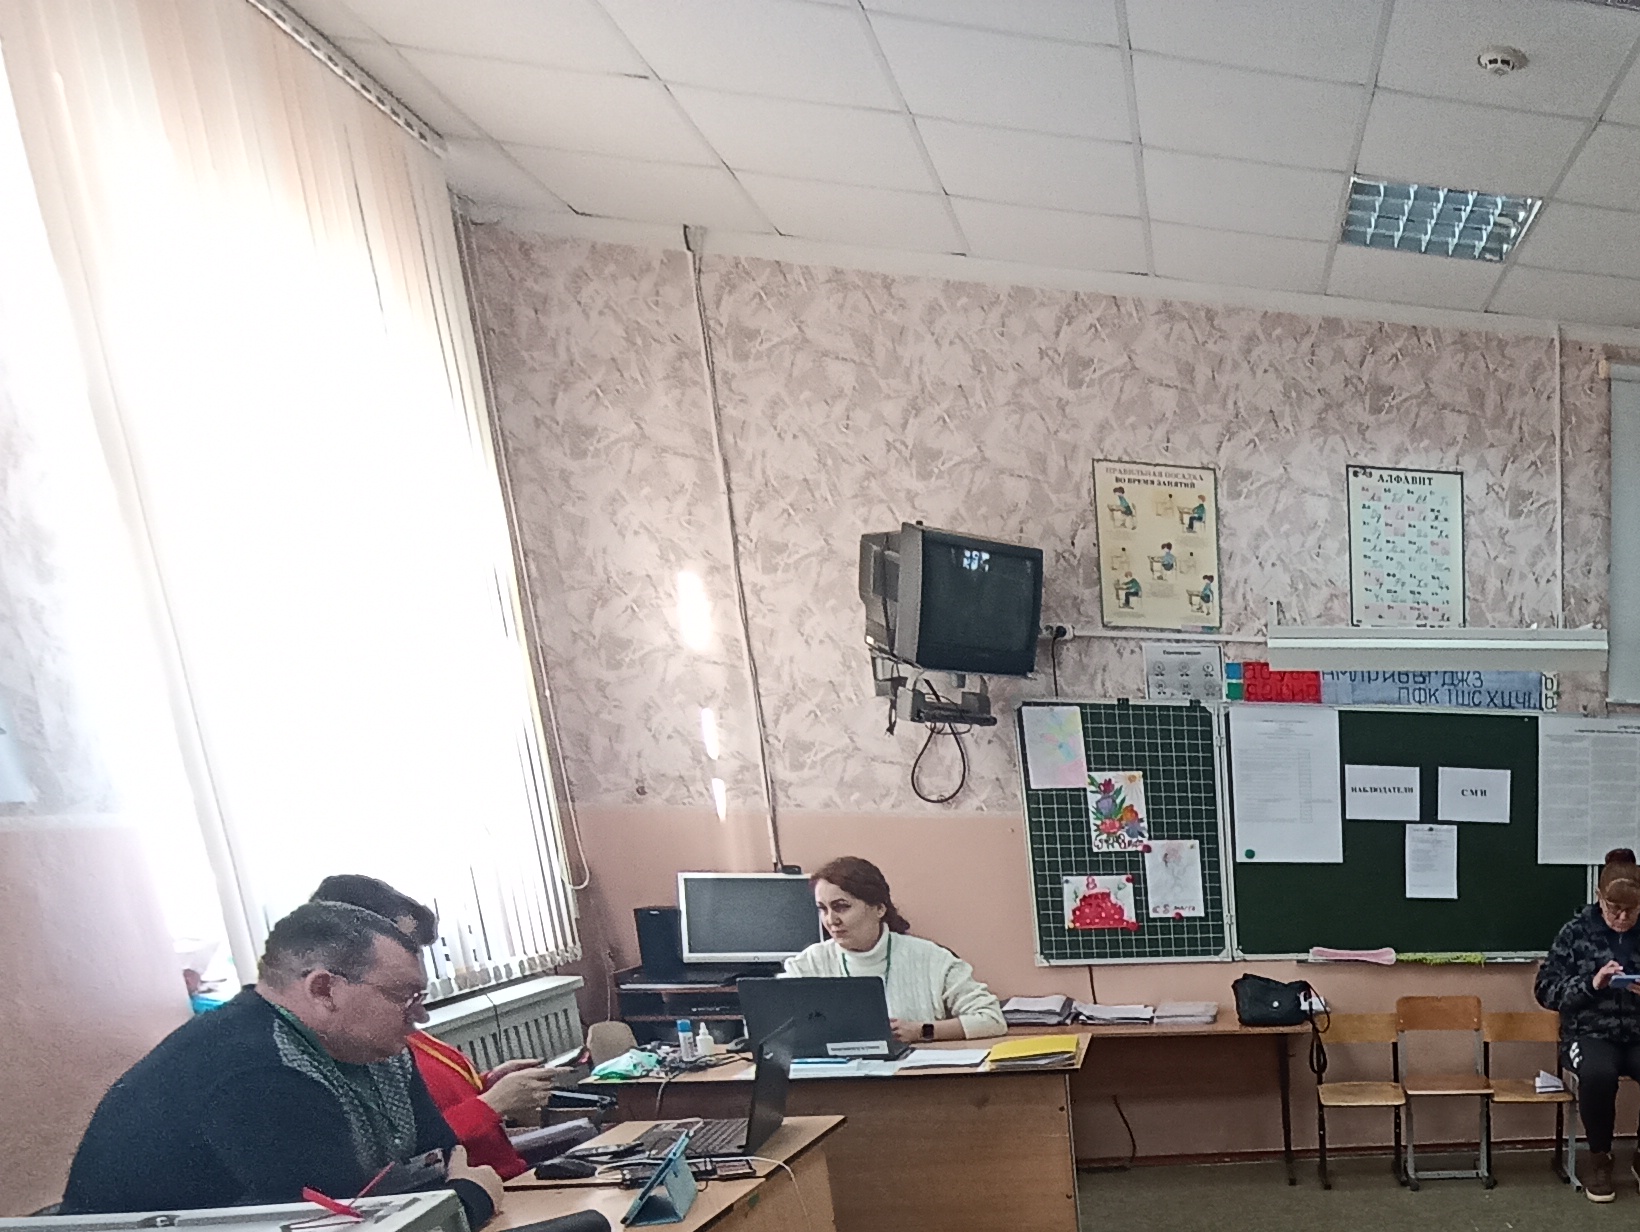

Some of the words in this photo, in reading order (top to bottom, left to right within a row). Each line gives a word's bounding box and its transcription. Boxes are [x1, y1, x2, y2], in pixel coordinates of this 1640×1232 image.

[1377, 473, 1434, 486] АЛФАВИТ
[1350, 786, 1414, 794] НАБЛЮДАТЕЛИ
[1461, 788, 1487, 797] СМИ
